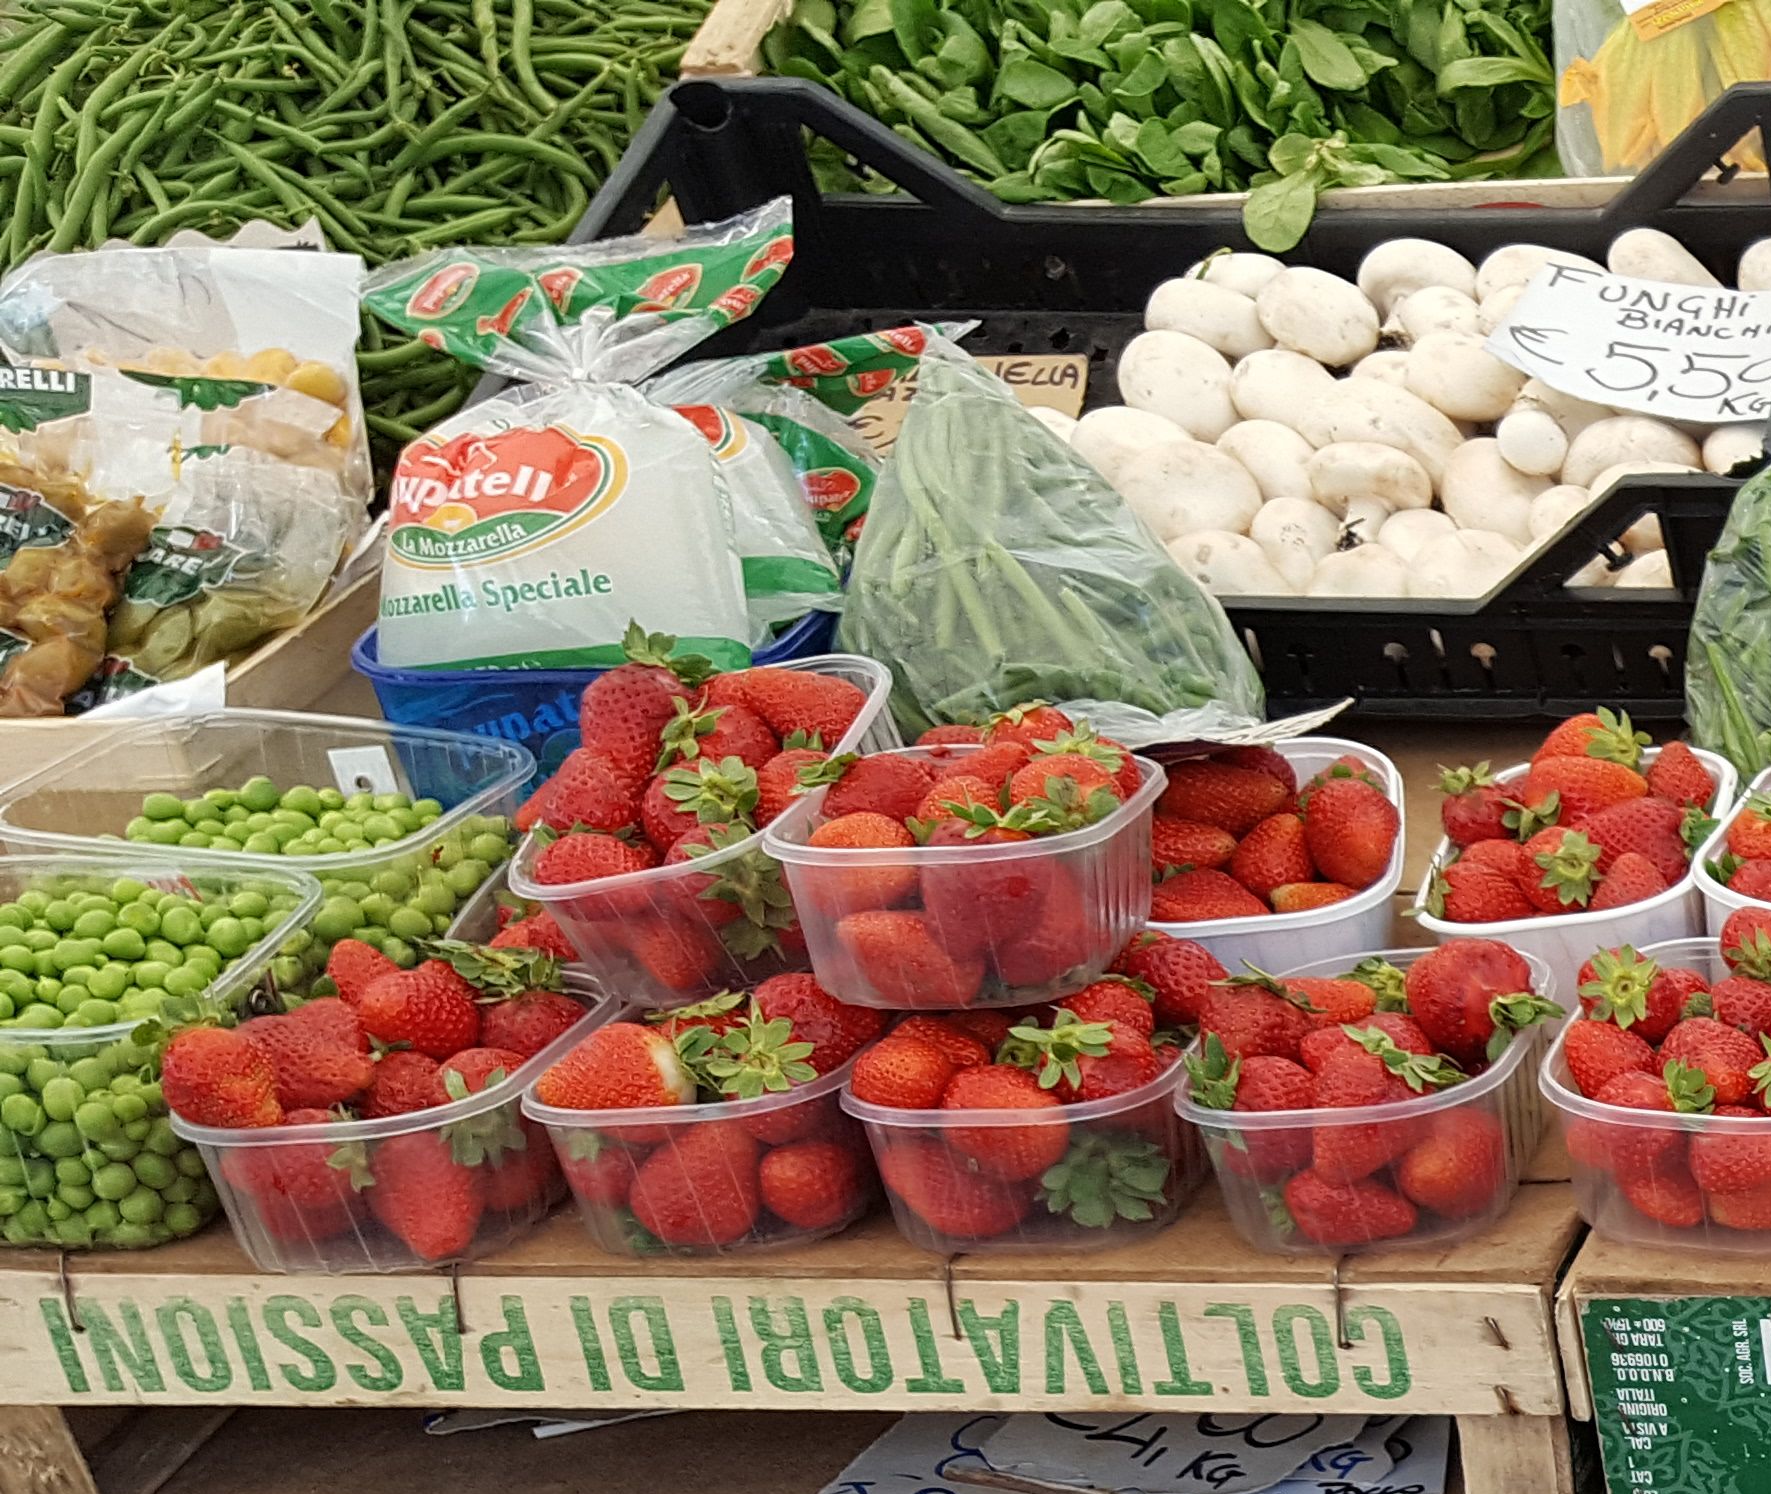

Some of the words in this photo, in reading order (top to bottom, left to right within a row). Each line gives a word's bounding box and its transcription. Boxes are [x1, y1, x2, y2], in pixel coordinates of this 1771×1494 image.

[419, 521, 528, 558] Mozzarella
[481, 568, 613, 612] Speciale
[38, 1295, 546, 1393] PASSIONI
[570, 1295, 685, 1393] DI
[712, 1296, 1413, 1400] COLTIVATORI
[1630, 1332, 1664, 1347] TARA
[1615, 1387, 1656, 1401] ITALIA
[1175, 1450, 1247, 1490] KG
